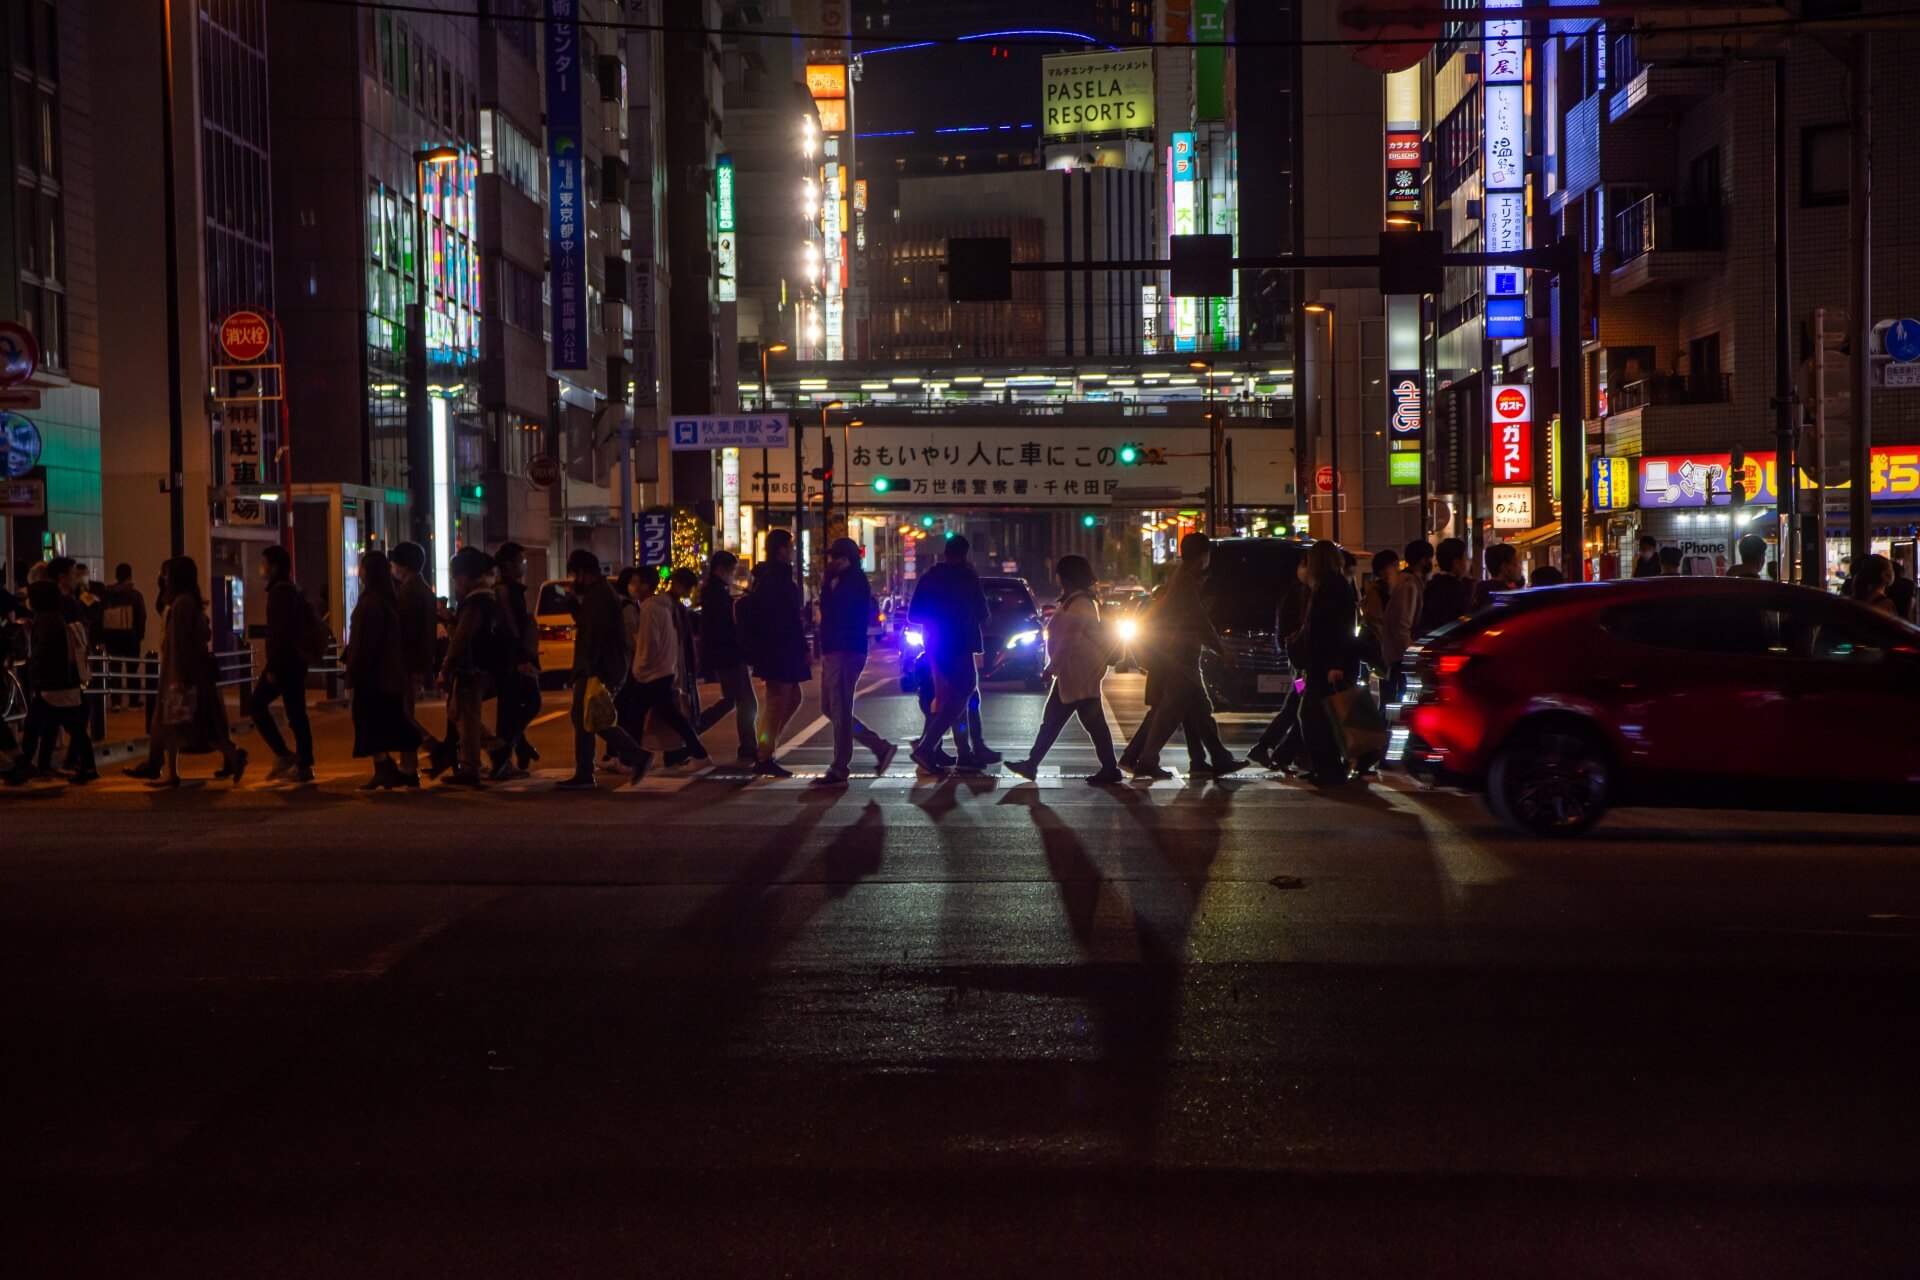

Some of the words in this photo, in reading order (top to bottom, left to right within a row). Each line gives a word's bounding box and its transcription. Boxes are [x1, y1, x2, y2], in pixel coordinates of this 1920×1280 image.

[1047, 78, 1122, 102] PASELA
[1048, 101, 1136, 125] RESORTS
[1388, 141, 1420, 150] カラオケ
[1501, 198, 1512, 270] エリアクエ
[226, 326, 265, 345] 消火栓
[229, 371, 254, 397] P
[1392, 380, 1421, 432] HUB
[1499, 401, 1524, 411] ガスト
[701, 419, 762, 434] 秋葉原駅
[703, 435, 743, 445] Akihabara
[745, 434, 761, 444] Sta.
[852, 440, 1167, 467] おもいやり人に車にこの
[1502, 424, 1520, 480] ガスト
[230, 430, 259, 519] 駐車場
[912, 479, 1120, 496] 万世橋警察署・千代田区
[644, 514, 666, 567] エフワン
[1680, 541, 1726, 554] iPhone
